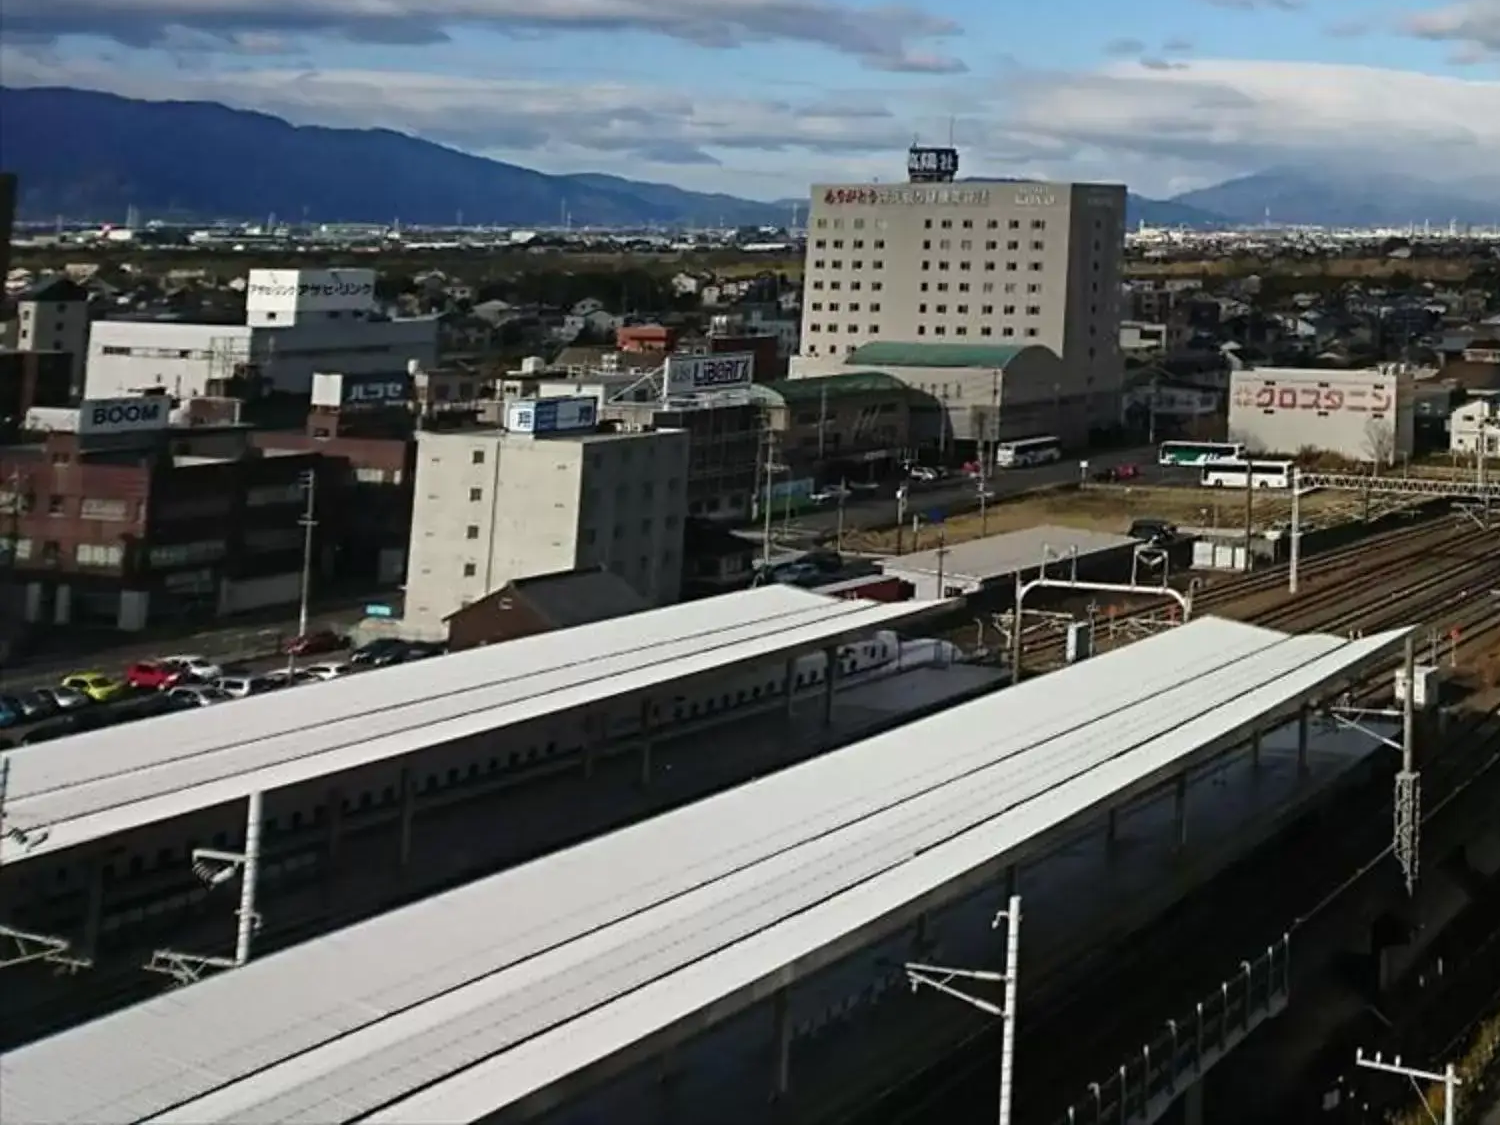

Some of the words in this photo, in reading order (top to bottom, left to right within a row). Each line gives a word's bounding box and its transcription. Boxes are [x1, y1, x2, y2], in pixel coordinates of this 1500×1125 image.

[1256, 388, 1391, 412] クロスタニン
[92, 404, 160, 425] BOOM
